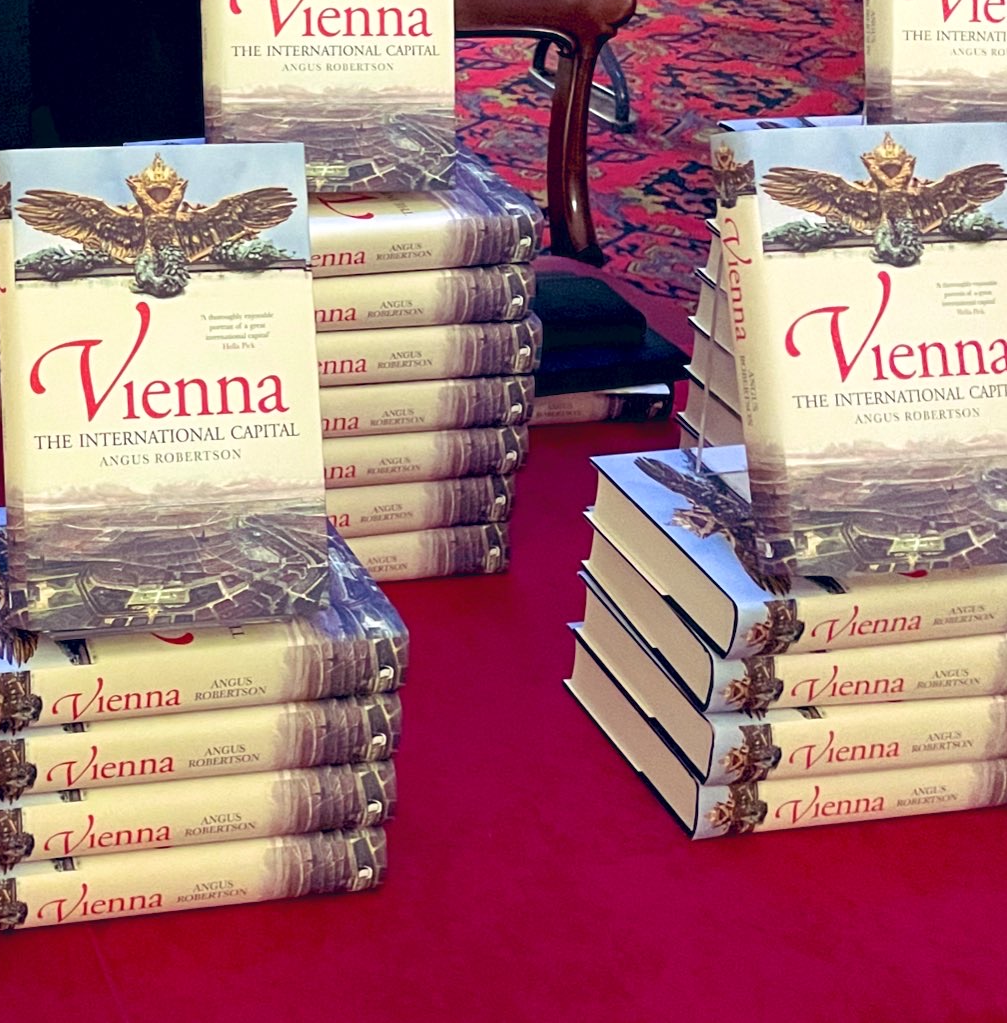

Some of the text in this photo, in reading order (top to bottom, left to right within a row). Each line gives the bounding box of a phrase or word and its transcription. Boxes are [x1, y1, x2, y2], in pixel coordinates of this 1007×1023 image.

[902, 30, 1007, 42] THE INTERNATI
[232, 44, 440, 57] THE INTERNATIONAL CAPITAL
[950, 48, 987, 56] ANGUS
[282, 63, 394, 72] ANGUS ROBERTSON
[391, 242, 423, 252] ANGUS
[310, 250, 366, 268] enna
[376, 250, 432, 261] ROBERTSON
[721, 218, 752, 340] Vienna
[380, 299, 413, 309] ANGUS
[314, 307, 357, 323] nna
[368, 307, 424, 318] ROBERTSON
[785, 270, 1007, 383] Vienna
[30, 302, 289, 422] Vienna
[391, 350, 423, 360] ANGUS
[377, 358, 433, 369] ROBERTSON
[792, 384, 1007, 409] THE INTERNATIONAL CAPIT
[382, 408, 415, 418] ANGUS
[855, 407, 980, 424] ANGUS ROBERTSON
[322, 414, 360, 432] nna
[370, 416, 425, 427] ROBERTSON
[34, 422, 300, 450] THE INTERNATIONAL CAPITAL
[99, 448, 242, 467] ANGUS ROBERTSON
[378, 456, 411, 467] ANGUS
[366, 463, 421, 476] ROBERTSON
[372, 503, 404, 514] ANGUS
[949, 604, 986, 616] ANGUS
[810, 606, 922, 644] Vienna
[933, 612, 996, 626] ROBERTSON
[932, 668, 969, 680] ANGUS
[210, 677, 253, 689] ANGUS
[790, 666, 905, 703] Vienna
[916, 677, 981, 690] ROBERTSON
[52, 677, 182, 721] Vienna
[194, 685, 267, 702] ROBERTSON
[927, 730, 963, 742] ANGUS
[204, 743, 246, 756] ANGUS
[789, 731, 900, 770] Vienna
[911, 739, 974, 753] ROBERTSON
[46, 745, 175, 788] Vienna
[188, 752, 261, 768] ROBERTSON
[912, 785, 947, 796] ANGUS
[775, 786, 885, 825] Vienna
[896, 793, 959, 808] ROBERTSON
[200, 812, 243, 826] ANGUS
[44, 814, 171, 856] Vienna
[184, 821, 256, 838] ROBERTSON
[192, 880, 235, 894] ANGUS
[176, 887, 248, 904] ROBERTSON
[37, 883, 163, 924] Vienna
